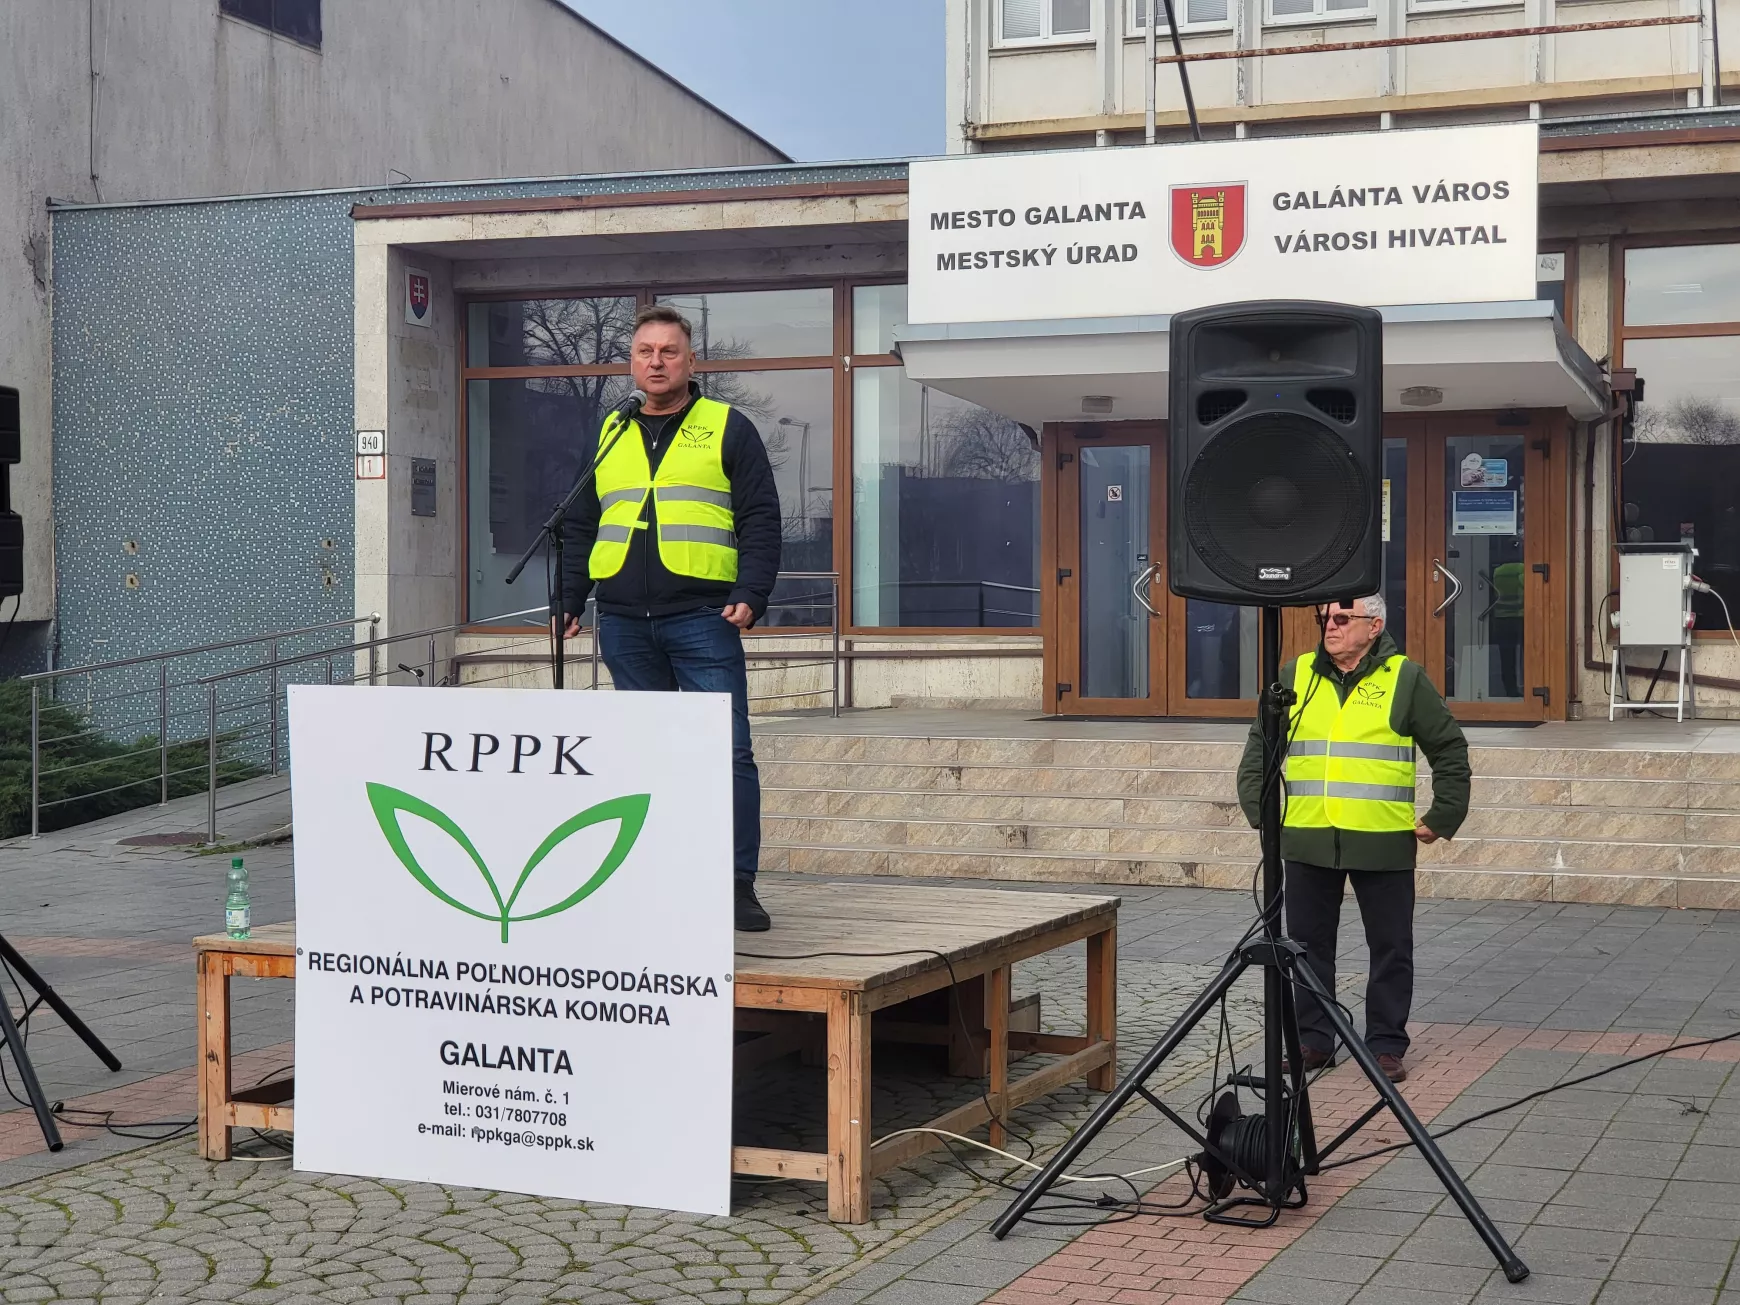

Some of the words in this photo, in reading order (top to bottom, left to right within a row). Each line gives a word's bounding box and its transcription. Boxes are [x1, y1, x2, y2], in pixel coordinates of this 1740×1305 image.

[1273, 184, 1403, 211] GALÁNTA
[1412, 179, 1510, 204] VÁROS
[930, 208, 1016, 231] MESTO
[1024, 201, 1146, 226] GALANTA
[1274, 229, 1377, 254] VÁROSI
[1388, 225, 1507, 249] HIVATAL
[937, 243, 1058, 271] MESTSKÝ
[1066, 242, 1138, 265] ÚRAD
[361, 436, 378, 450] 940
[367, 459, 372, 473] 1
[1352, 700, 1382, 710] GALANTA
[418, 731, 595, 776] RPPK
[308, 951, 450, 980] REGIONÁLNA
[456, 961, 718, 998] POĽNOHOSPODÁRSKA
[349, 984, 365, 1004] A
[371, 985, 558, 1019] POTRAVINÁRSKA
[565, 999, 670, 1026] KOMORA
[439, 1040, 574, 1076] GALANTA
[442, 1080, 500, 1099] Mierové
[505, 1086, 540, 1103] nám.
[544, 1088, 557, 1104] č.
[562, 1091, 570, 1105] 1
[443, 1102, 471, 1117] tel.:
[475, 1104, 568, 1127] 031/7807708
[417, 1123, 466, 1138] e-mail:
[470, 1125, 596, 1152] rppkga@sppk.sk
